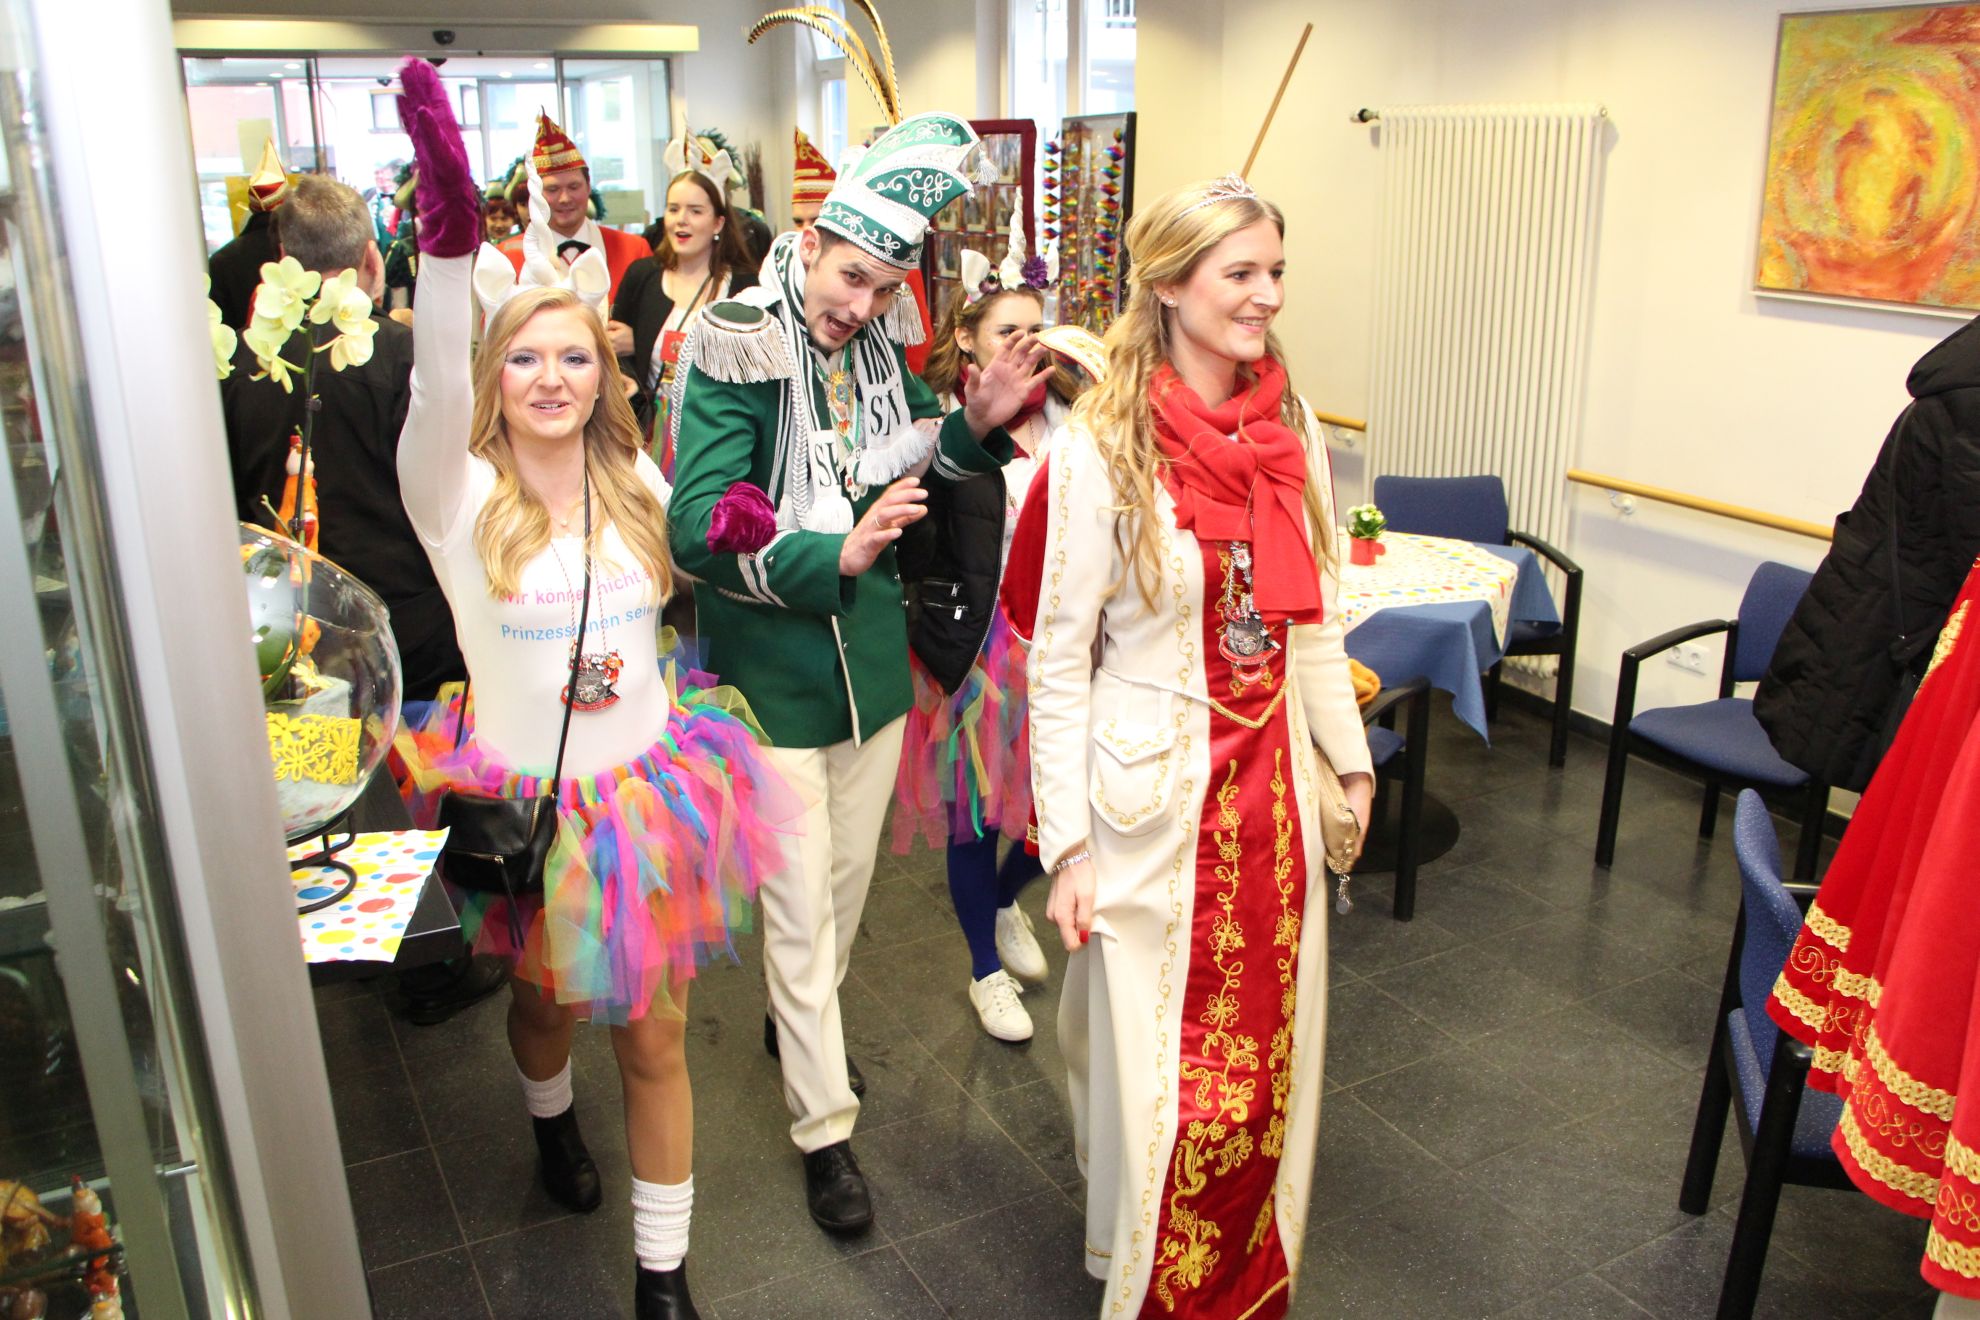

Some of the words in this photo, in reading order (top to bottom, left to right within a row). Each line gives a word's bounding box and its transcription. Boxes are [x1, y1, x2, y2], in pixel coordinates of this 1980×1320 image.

[535, 587, 590, 606] könne
[597, 568, 641, 596] nicht
[501, 613, 620, 641] Prinzessinen
